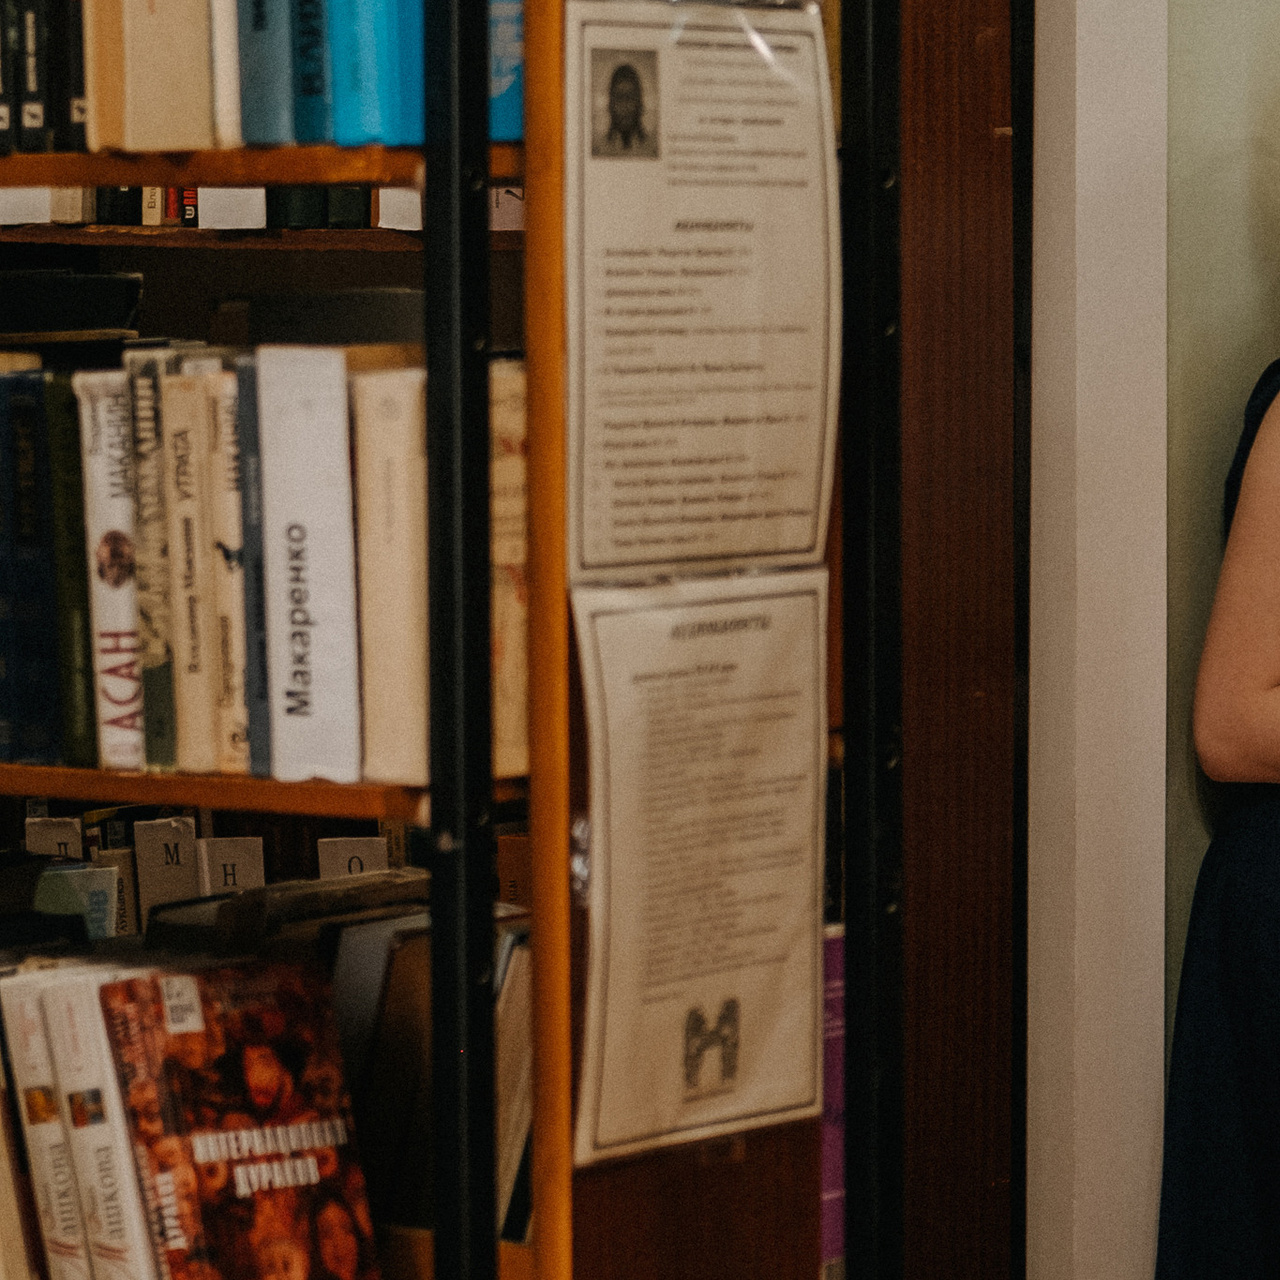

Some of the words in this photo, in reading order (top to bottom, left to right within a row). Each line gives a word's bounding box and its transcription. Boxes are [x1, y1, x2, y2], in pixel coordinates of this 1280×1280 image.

[285, 523, 310, 717] Макаренко
[99, 630, 140, 731] АСАН
[163, 842, 181, 866] М
[222, 862, 237, 887] Н
